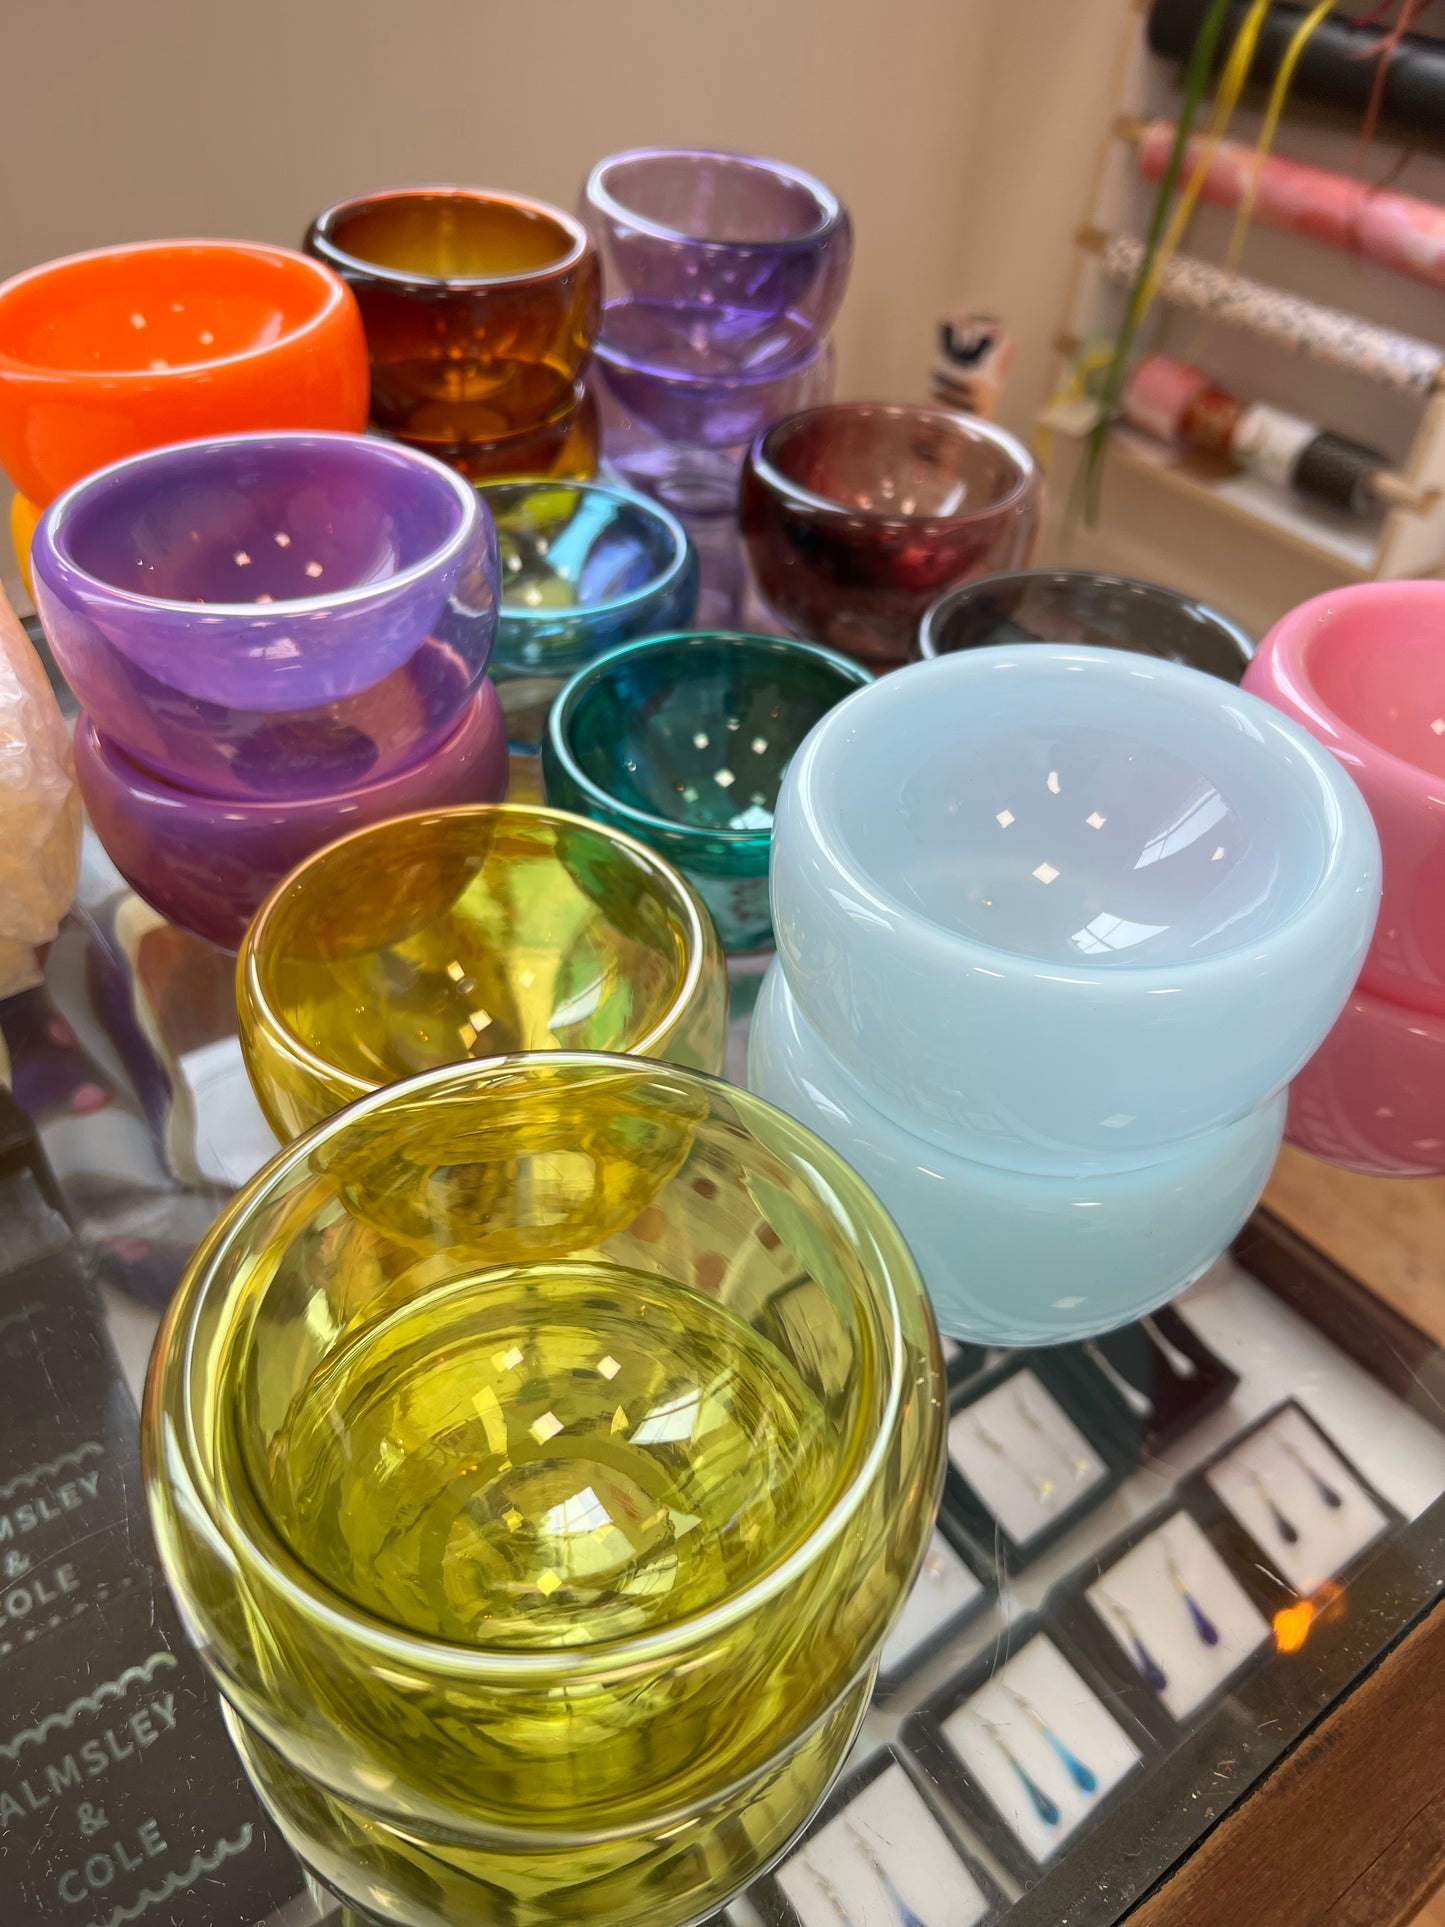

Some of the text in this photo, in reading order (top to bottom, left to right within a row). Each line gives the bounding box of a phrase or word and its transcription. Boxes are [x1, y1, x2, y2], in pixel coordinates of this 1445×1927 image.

[4, 1549, 31, 1578] &
[0, 1563, 81, 1628] OLE
[77, 1801, 110, 1836] &
[58, 1817, 168, 1903] COLE
